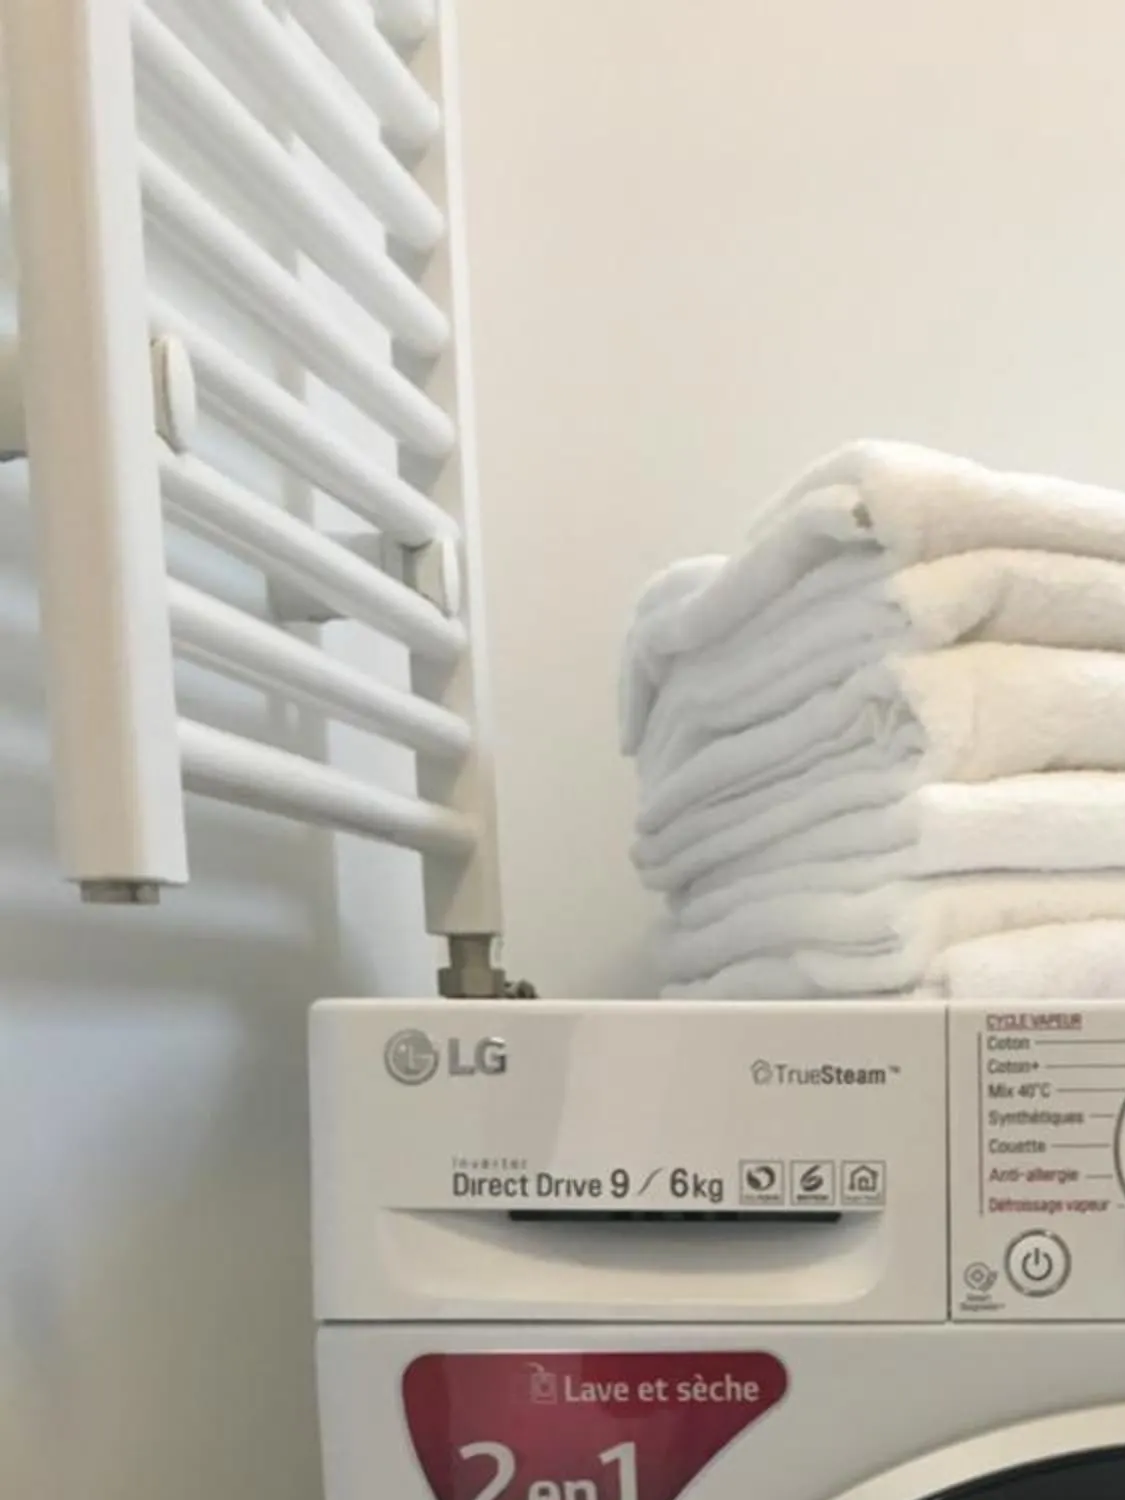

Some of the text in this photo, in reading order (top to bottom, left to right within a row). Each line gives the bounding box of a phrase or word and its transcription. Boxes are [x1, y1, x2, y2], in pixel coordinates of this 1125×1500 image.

[987, 1036, 1030, 1050] Coton
[447, 1036, 507, 1077] LG
[987, 1059, 1040, 1073] Coton+
[988, 1083, 1014, 1098] Mix
[988, 1109, 1084, 1127] Synthétiques
[988, 1139, 1046, 1153] Couette
[989, 1167, 1079, 1184] Anti-allergie
[453, 1172, 528, 1197] Direct
[536, 1172, 602, 1198] Drive
[611, 1168, 630, 1198] 9
[670, 1168, 724, 1203] 6kg
[564, 1372, 760, 1402] Lave et sèche
